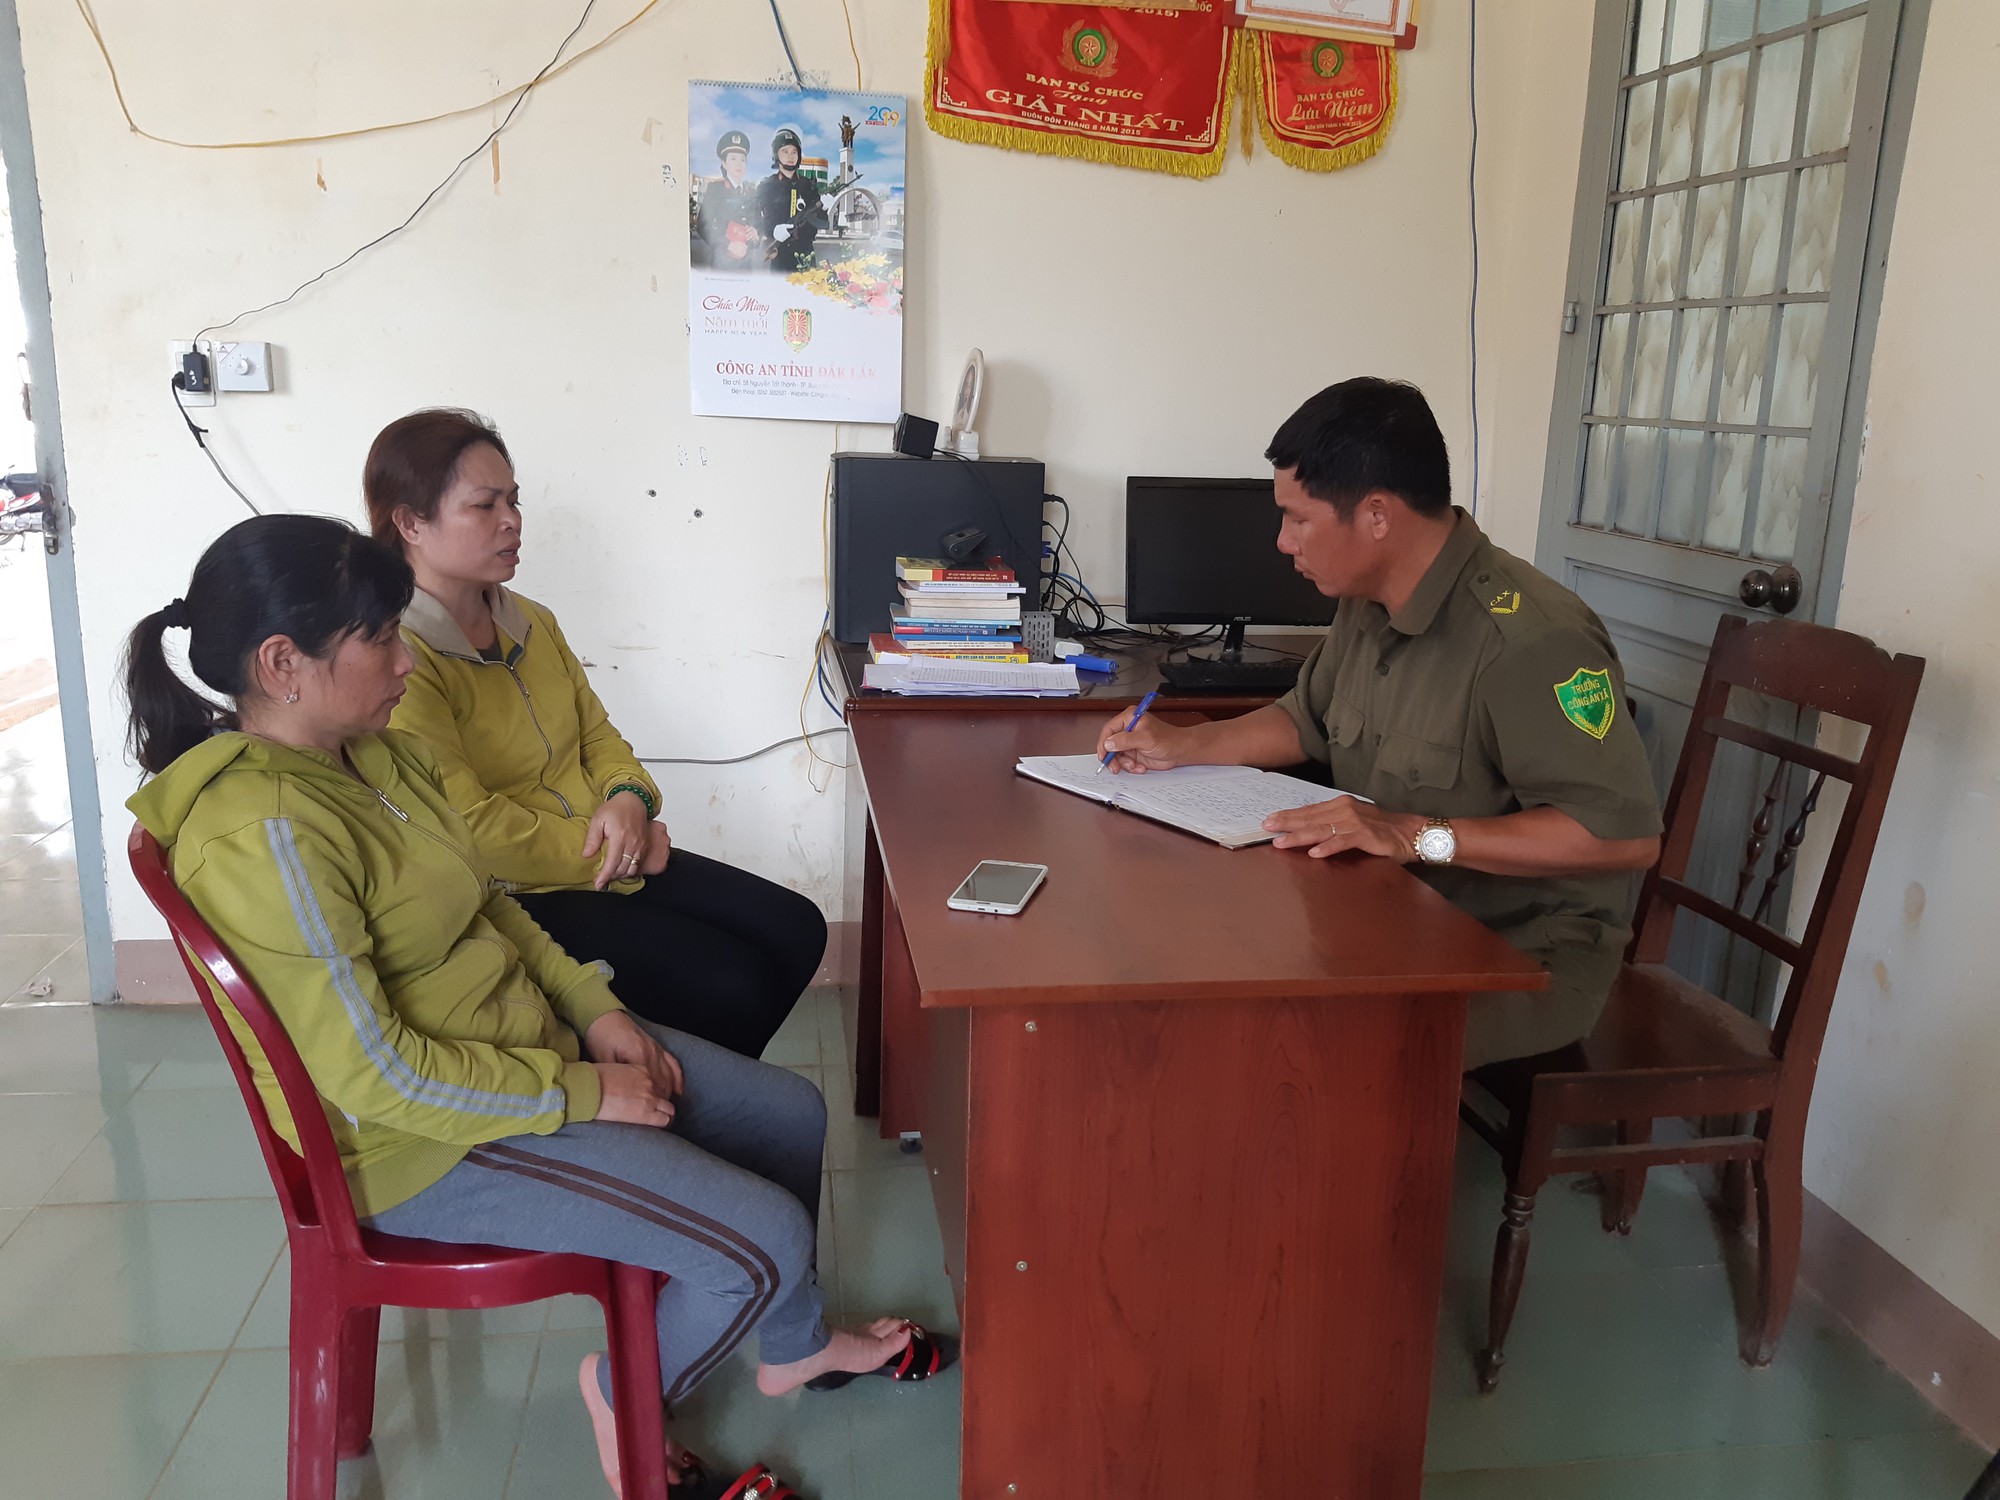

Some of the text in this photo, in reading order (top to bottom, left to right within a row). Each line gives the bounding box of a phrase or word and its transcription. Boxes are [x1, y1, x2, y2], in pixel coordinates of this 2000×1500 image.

[1025, 72, 1062, 88] BAN
[1094, 86, 1144, 100] CHỨC
[1297, 93, 1317, 102] BAN
[1335, 88, 1365, 99] CHỨC
[868, 105, 900, 127] 2019
[985, 88, 1185, 132] GIẢI NHẤT
[1021, 110, 1043, 121] BUÔN
[1064, 119, 1090, 130] THÁNG
[703, 295, 733, 310] Chúc
[704, 316, 737, 329] Năm
[716, 359, 754, 376] CÔNG
[758, 364, 777, 376] AN
[780, 361, 813, 377] TỈNH
